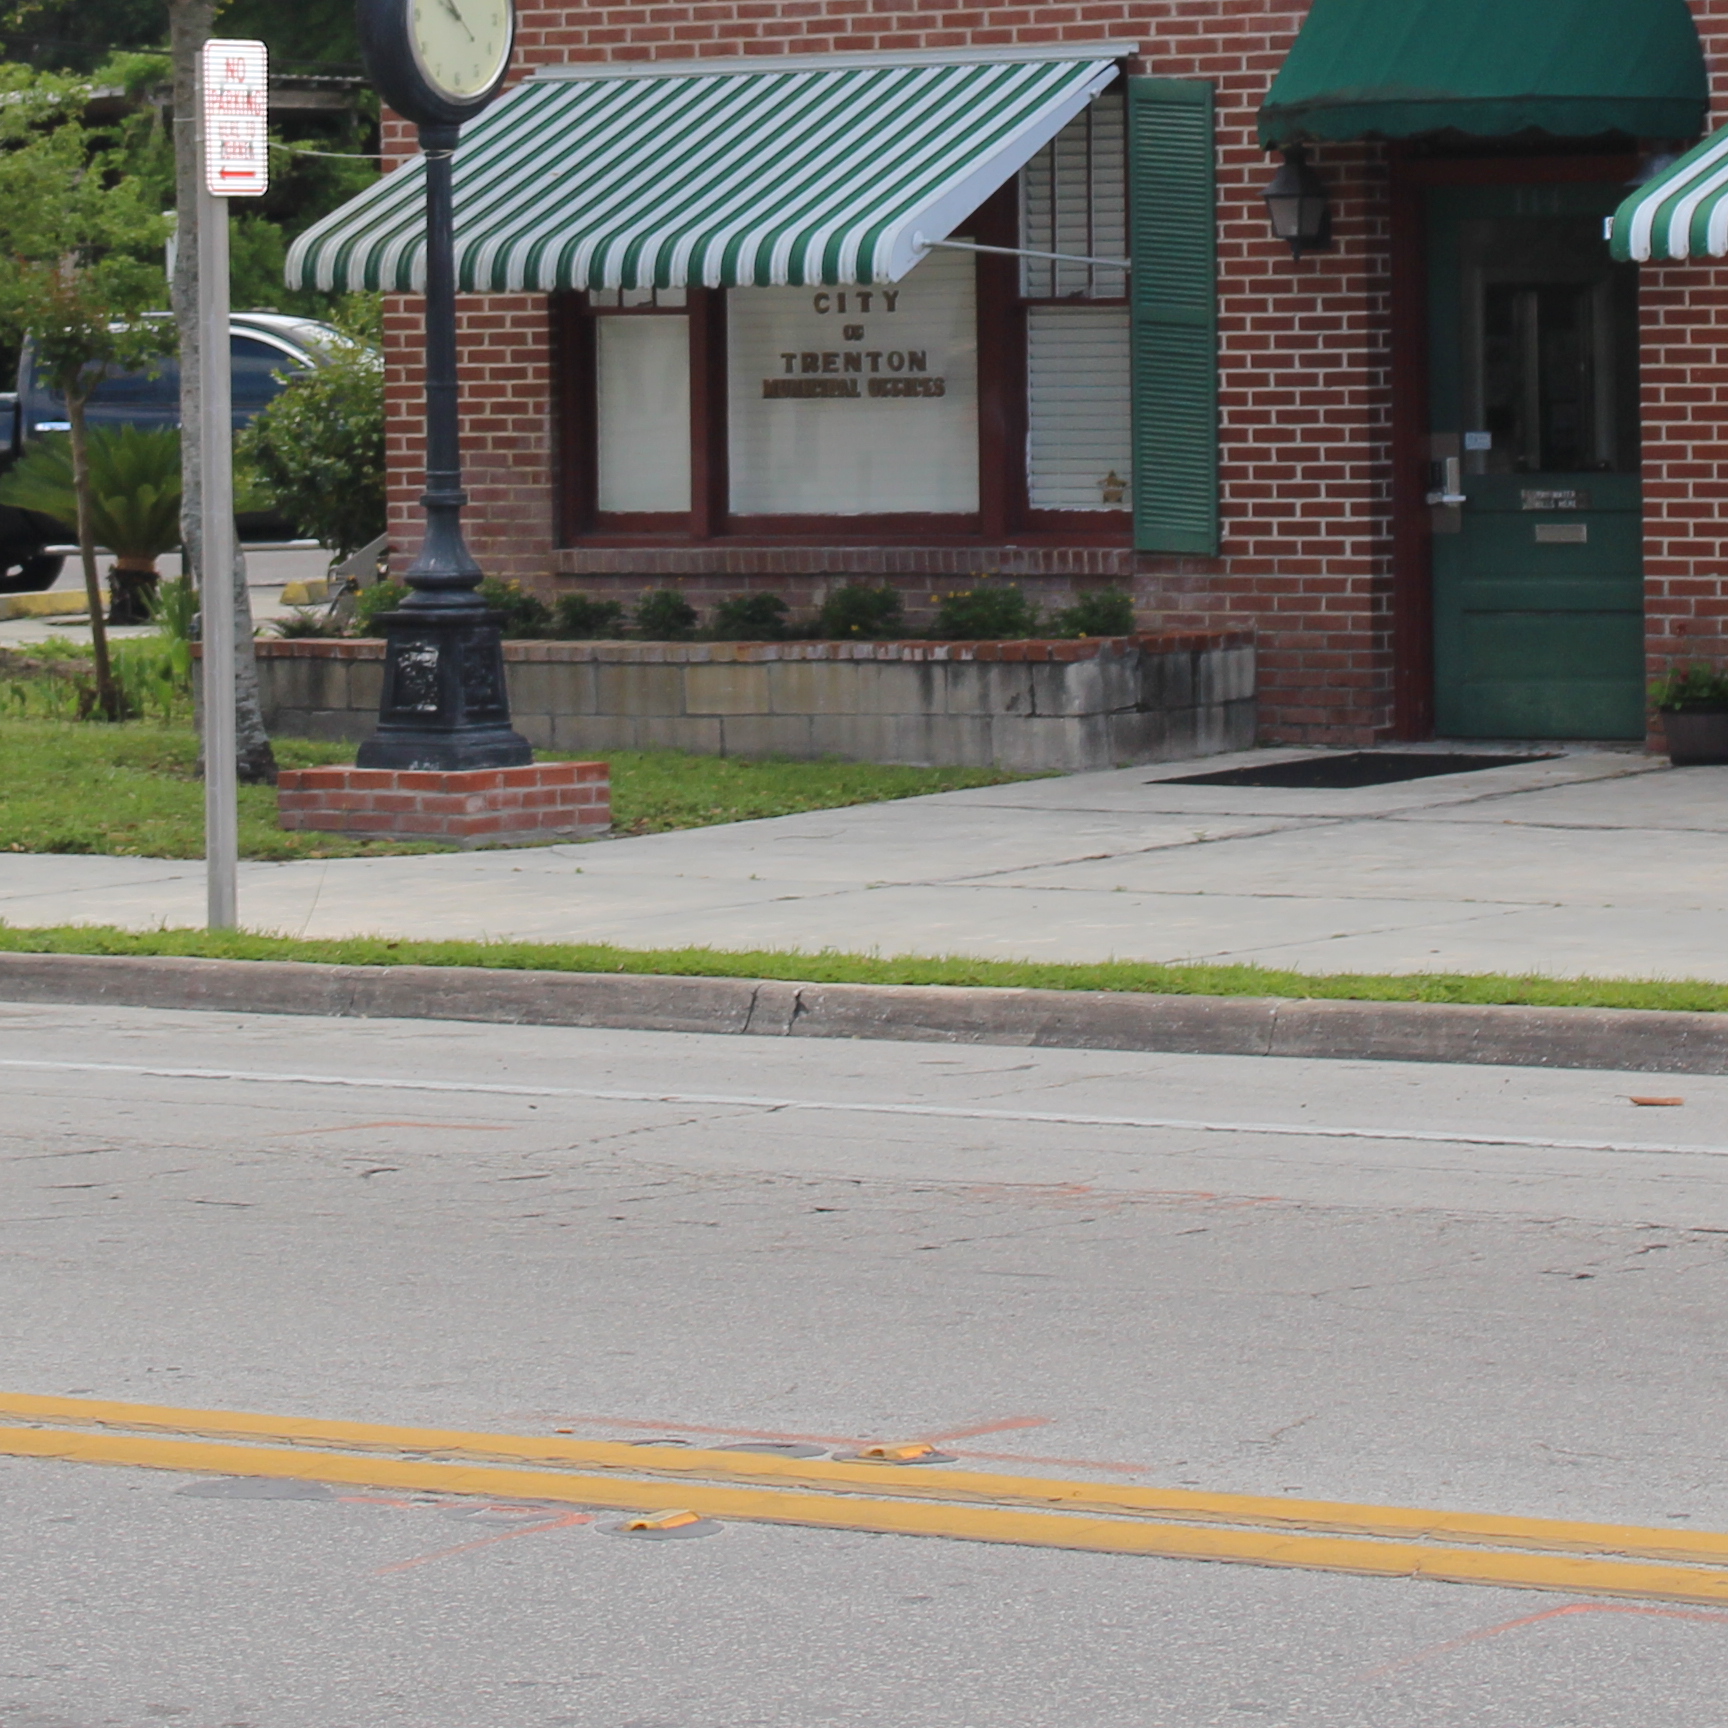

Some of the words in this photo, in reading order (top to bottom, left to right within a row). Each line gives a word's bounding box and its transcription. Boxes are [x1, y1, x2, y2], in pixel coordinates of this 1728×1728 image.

[226, 58, 245, 83] NO
[206, 90, 266, 115] PARKING
[813, 290, 899, 314] CITY
[843, 324, 865, 341] OF
[780, 350, 927, 373] TRENTON
[762, 378, 862, 399] MUNICIPAL
[867, 377, 946, 398] OFFICES
